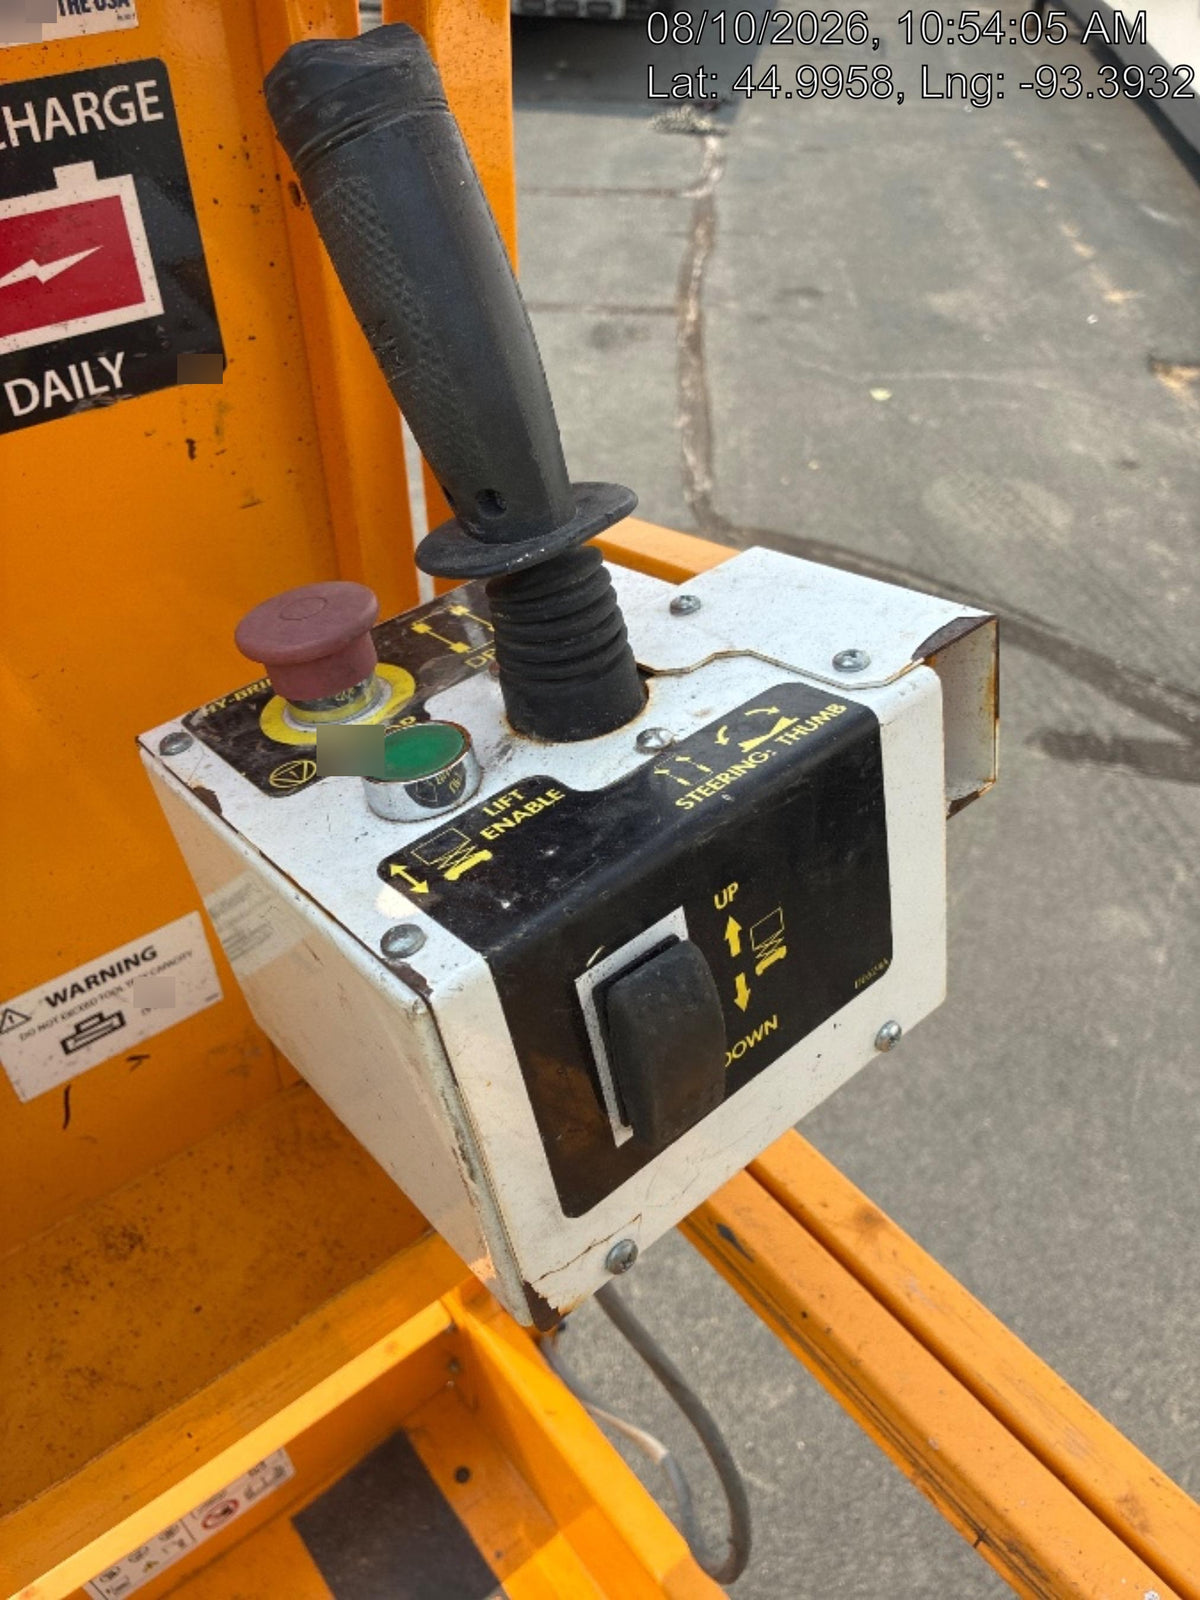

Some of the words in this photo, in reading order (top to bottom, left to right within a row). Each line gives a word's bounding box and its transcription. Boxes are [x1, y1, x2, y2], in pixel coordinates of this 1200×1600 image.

[0, 80, 165, 149] HARGE
[4, 351, 126, 417] DAILY
[675, 749, 778, 811] STEERING:
[774, 702, 848, 747] THUMB
[479, 788, 565, 840] ENABLE
[482, 788, 527, 818] LIFT
[714, 882, 740, 910] UP
[45, 945, 158, 1008] WARNING
